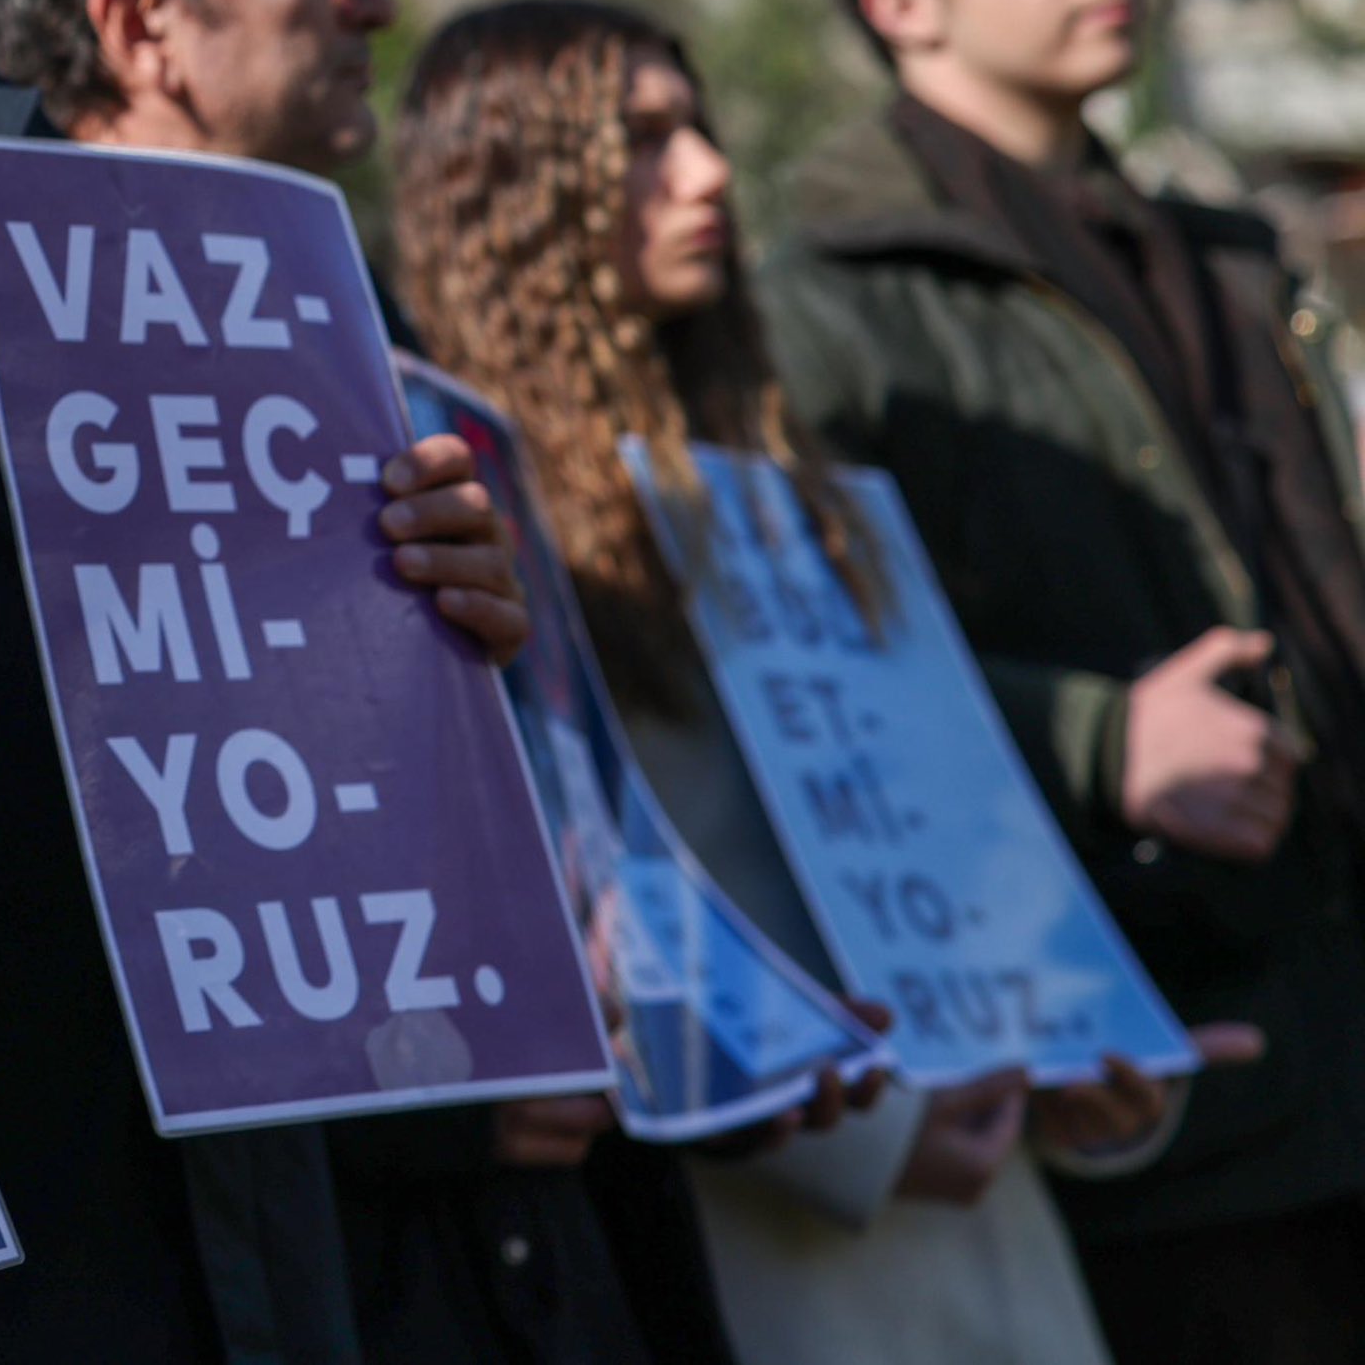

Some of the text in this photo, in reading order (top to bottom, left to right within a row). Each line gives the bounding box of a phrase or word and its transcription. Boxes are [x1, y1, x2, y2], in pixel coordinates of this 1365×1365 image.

[6, 221, 331, 349] VAZ-
[46, 391, 379, 539] GEÇ-
[74, 524, 307, 685] Mİ-
[106, 728, 379, 856] YO-
[154, 888, 504, 1032] RUZ.
